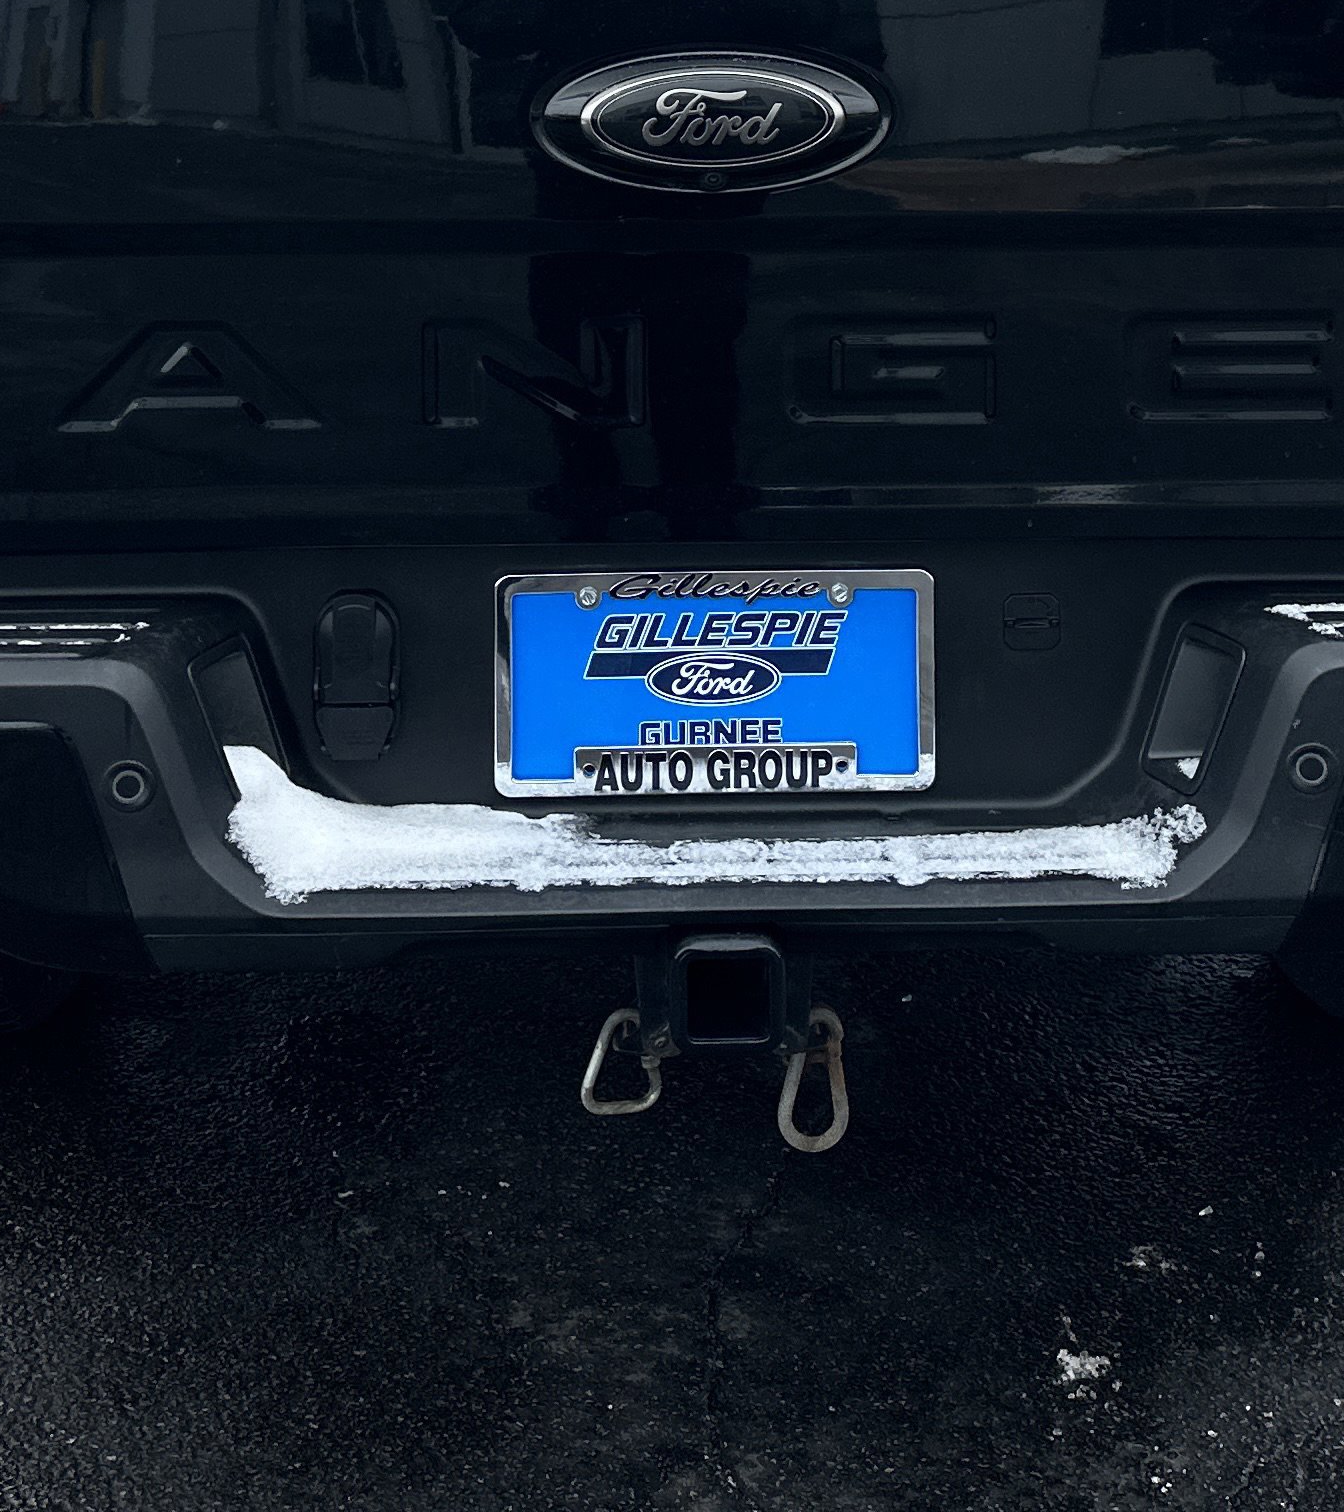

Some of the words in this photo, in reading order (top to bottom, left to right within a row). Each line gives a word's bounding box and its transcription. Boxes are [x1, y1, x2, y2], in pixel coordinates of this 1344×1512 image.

[641, 88, 780, 146] Ford
[608, 573, 820, 605] Gillespie
[594, 610, 849, 650] GILLESPIE
[671, 661, 755, 695] Ford
[638, 718, 784, 745] GURNEE
[594, 749, 694, 791] AUTO
[707, 748, 833, 790] GROUP
